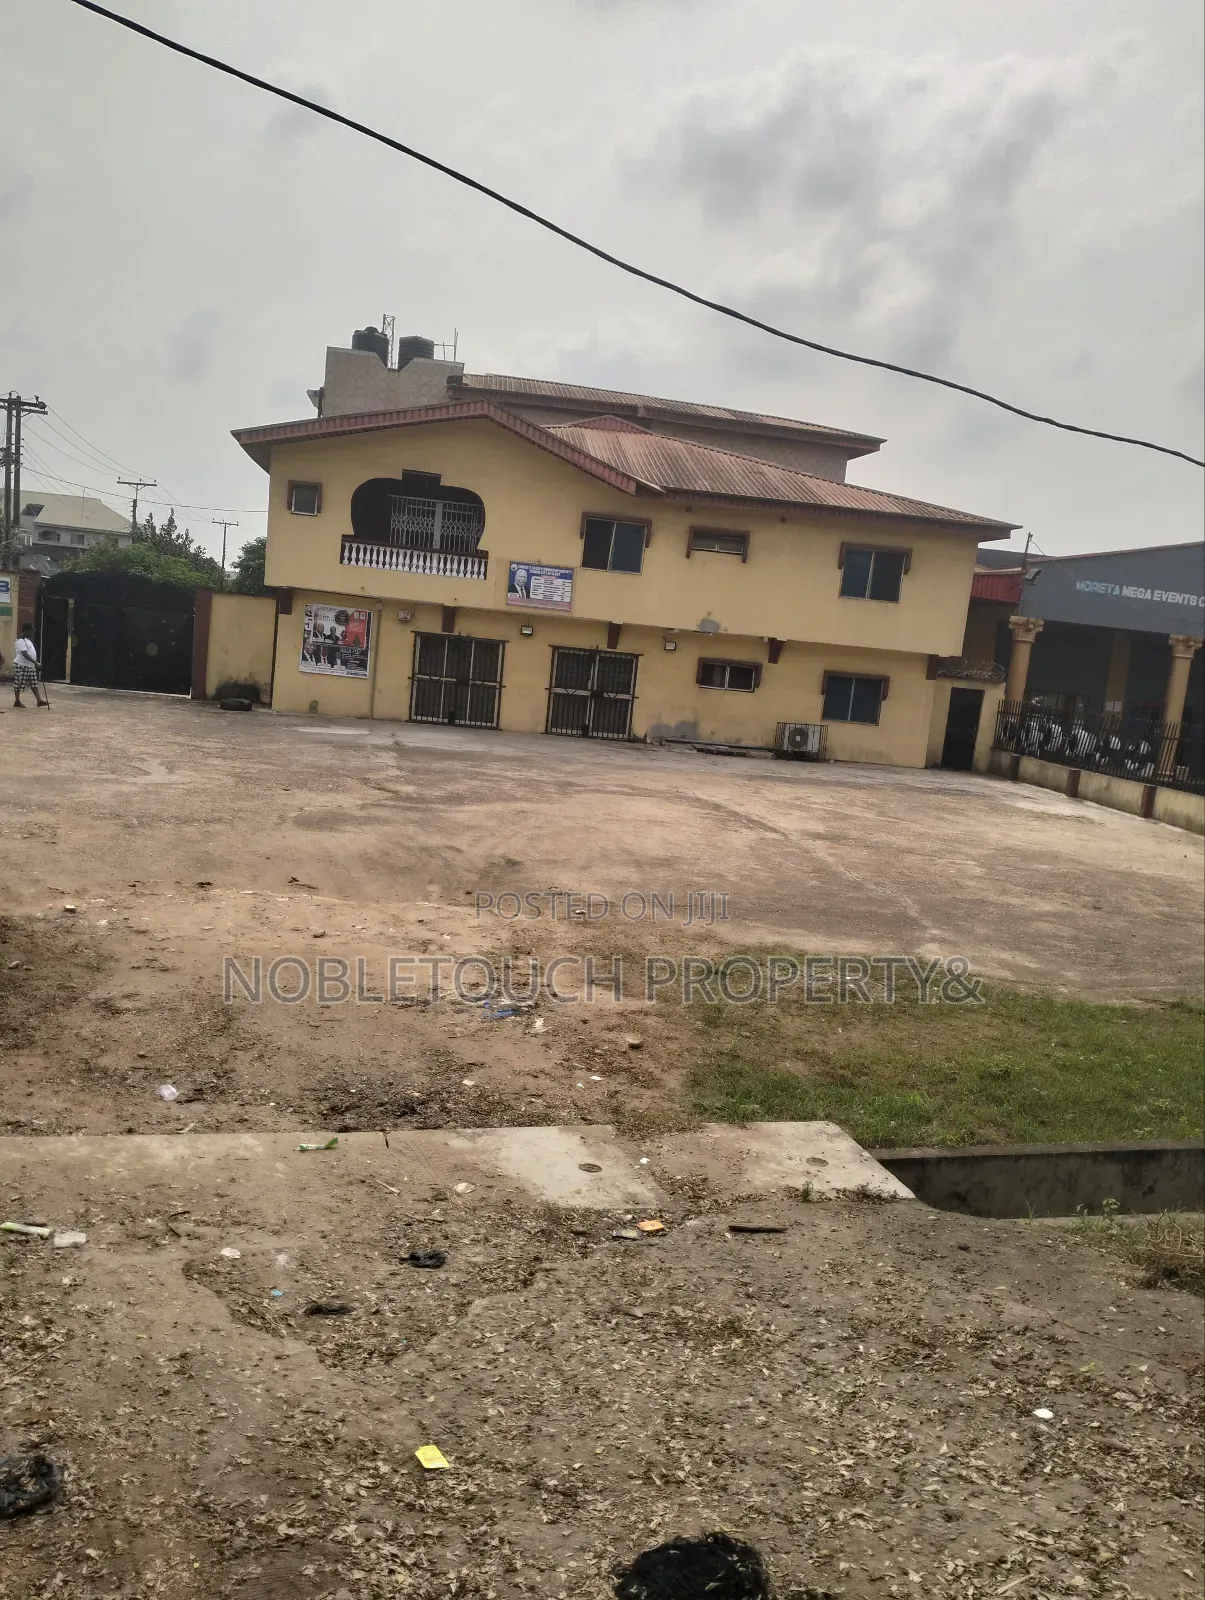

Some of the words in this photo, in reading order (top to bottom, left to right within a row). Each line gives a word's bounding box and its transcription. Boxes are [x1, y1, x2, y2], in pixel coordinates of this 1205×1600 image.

[1076, 581, 1120, 595] MORETA
[1122, 586, 1151, 600] MEGA
[1153, 590, 1198, 606] EVENTS
